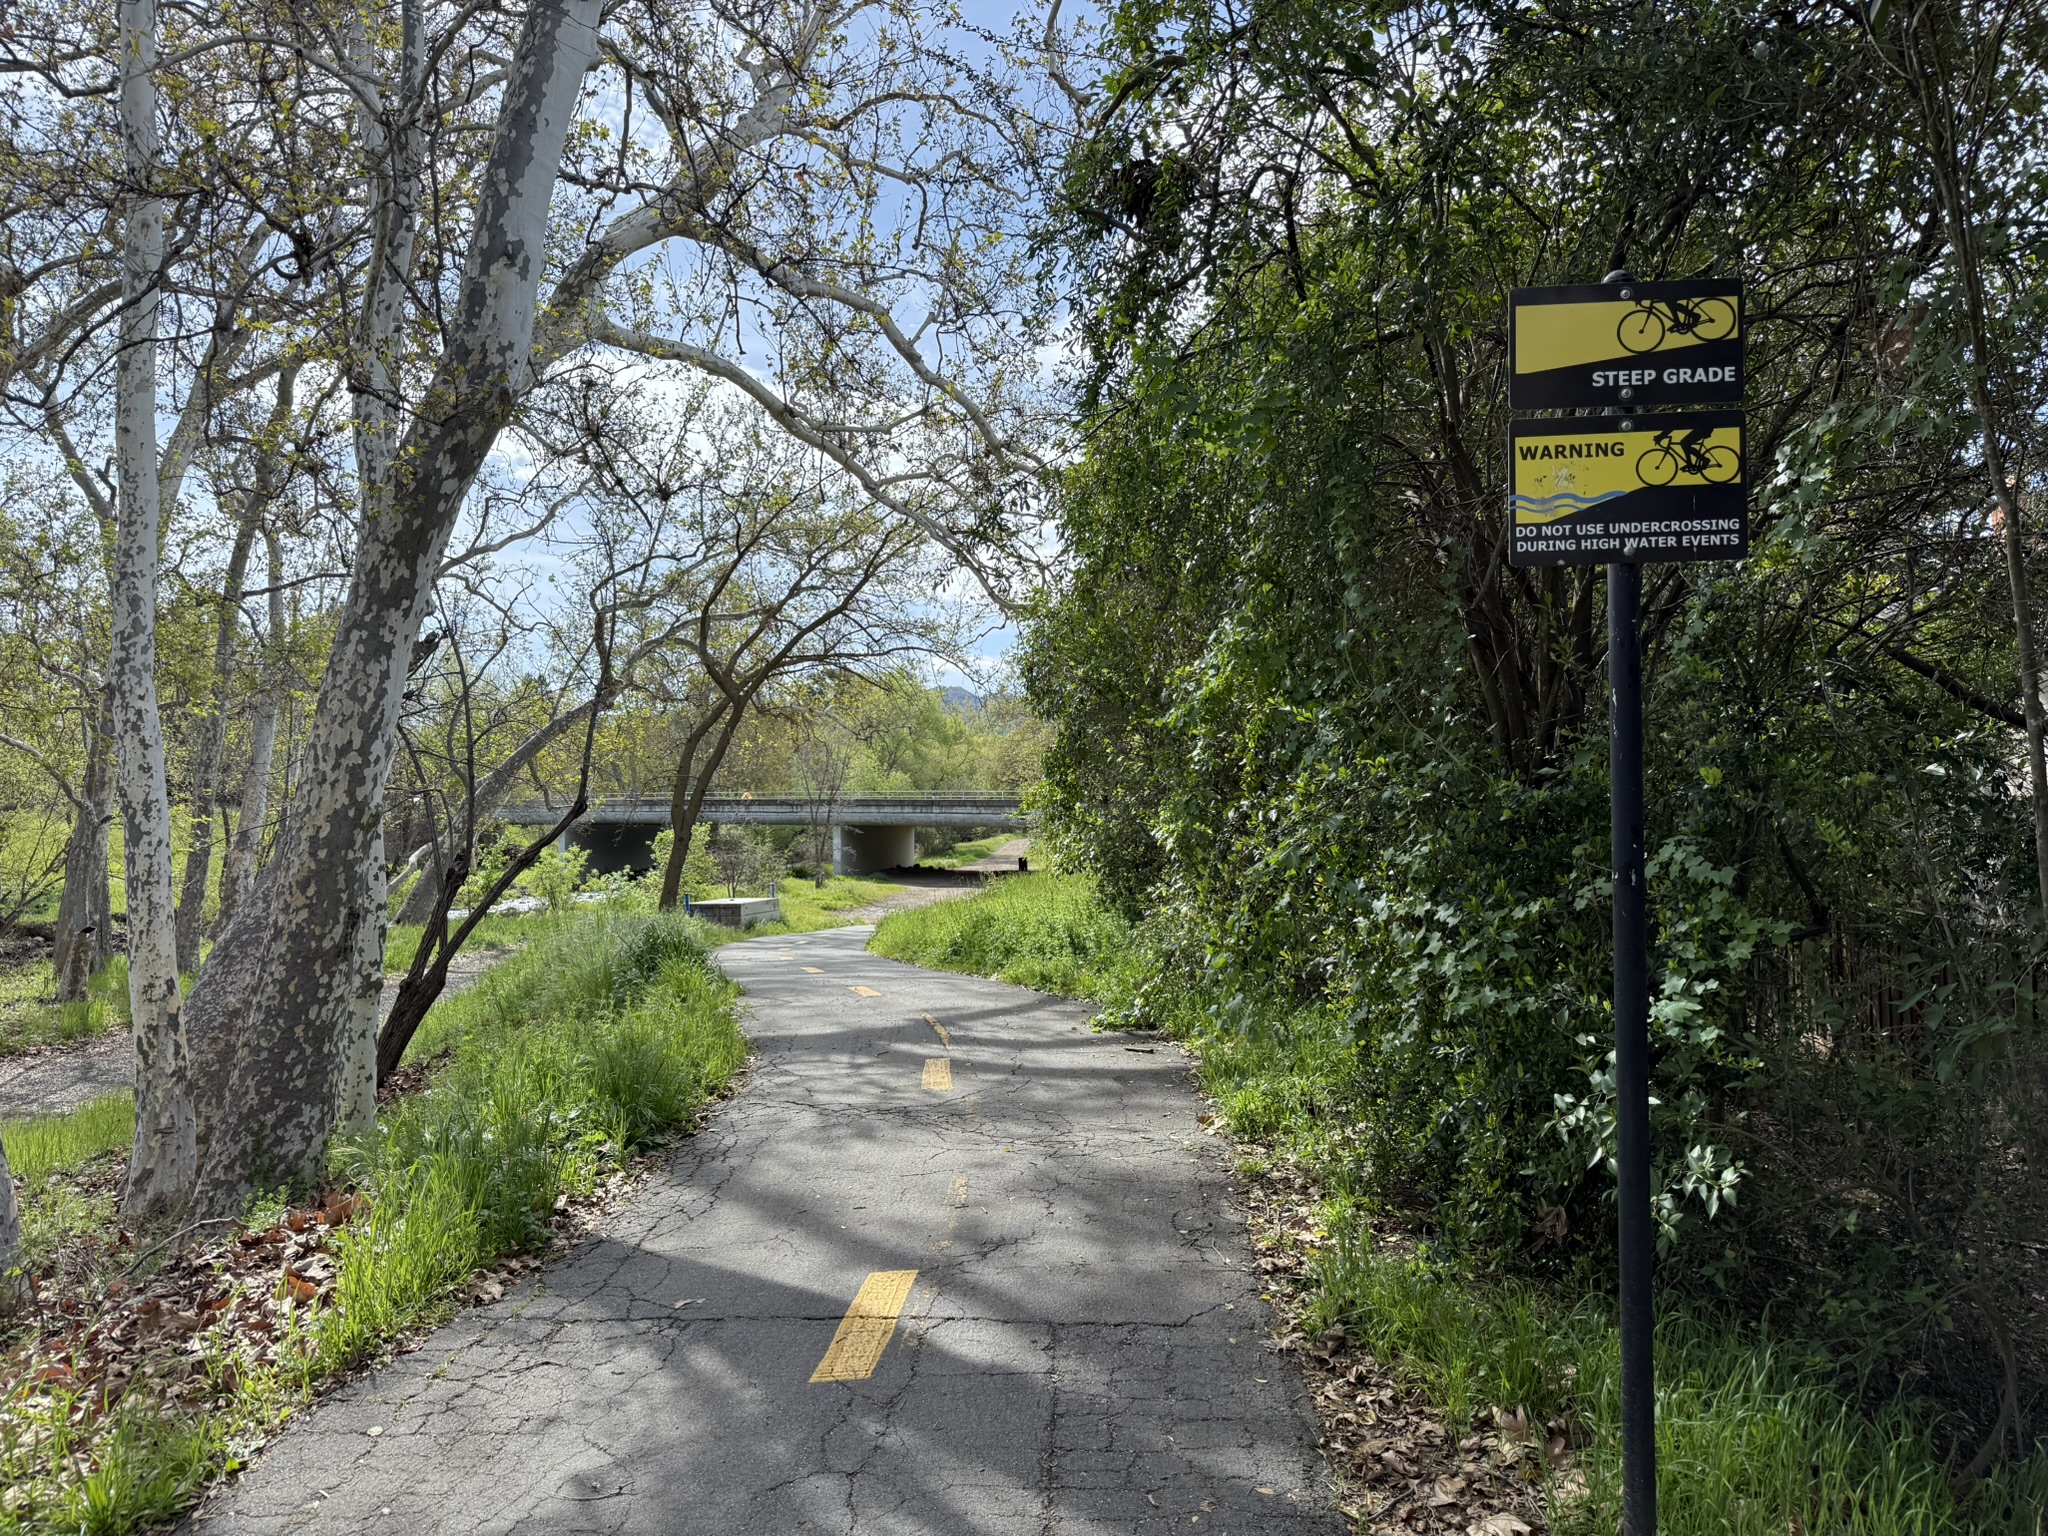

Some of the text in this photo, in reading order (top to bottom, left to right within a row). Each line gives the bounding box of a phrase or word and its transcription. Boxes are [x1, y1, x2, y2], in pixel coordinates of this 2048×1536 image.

[1592, 366, 1736, 387] STEEP GRADE
[1519, 442, 1625, 461] WARNING
[1515, 518, 1740, 538] DO NOT USE UNDERCROSSING
[1516, 534, 1740, 552] DURING HIGH WATER EVENTS
